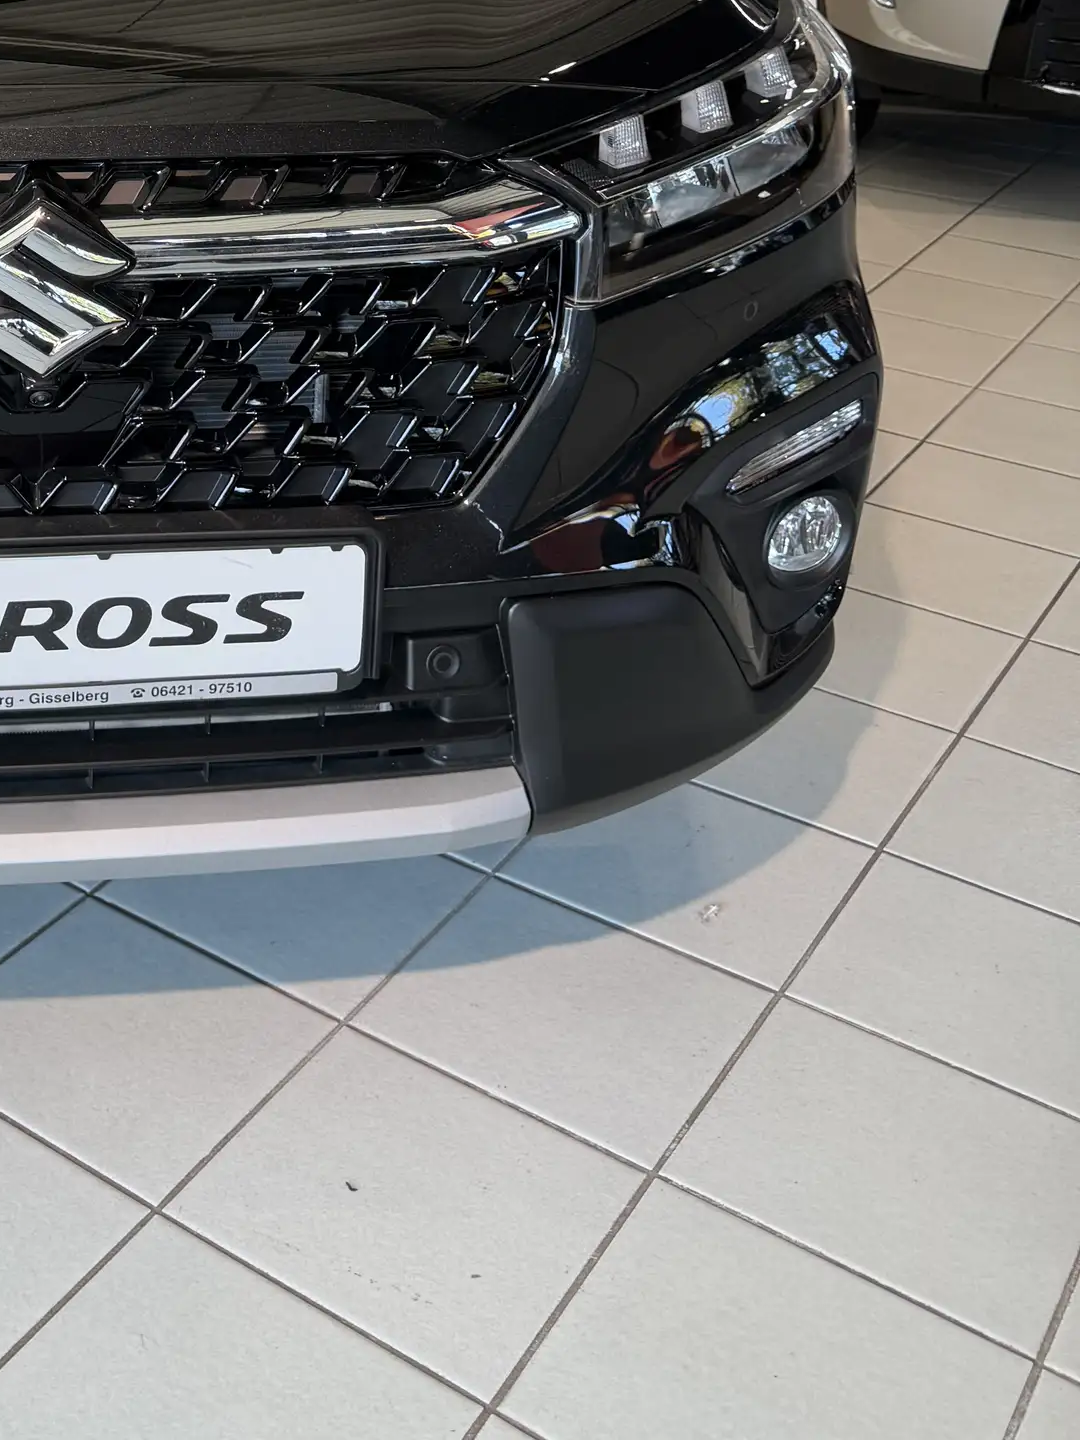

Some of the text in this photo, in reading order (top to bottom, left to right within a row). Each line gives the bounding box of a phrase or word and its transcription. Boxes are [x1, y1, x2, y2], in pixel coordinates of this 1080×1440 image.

[29, 689, 110, 705] Gisselberg
[151, 684, 193, 698] 06421
[208, 681, 253, 694] 97510
